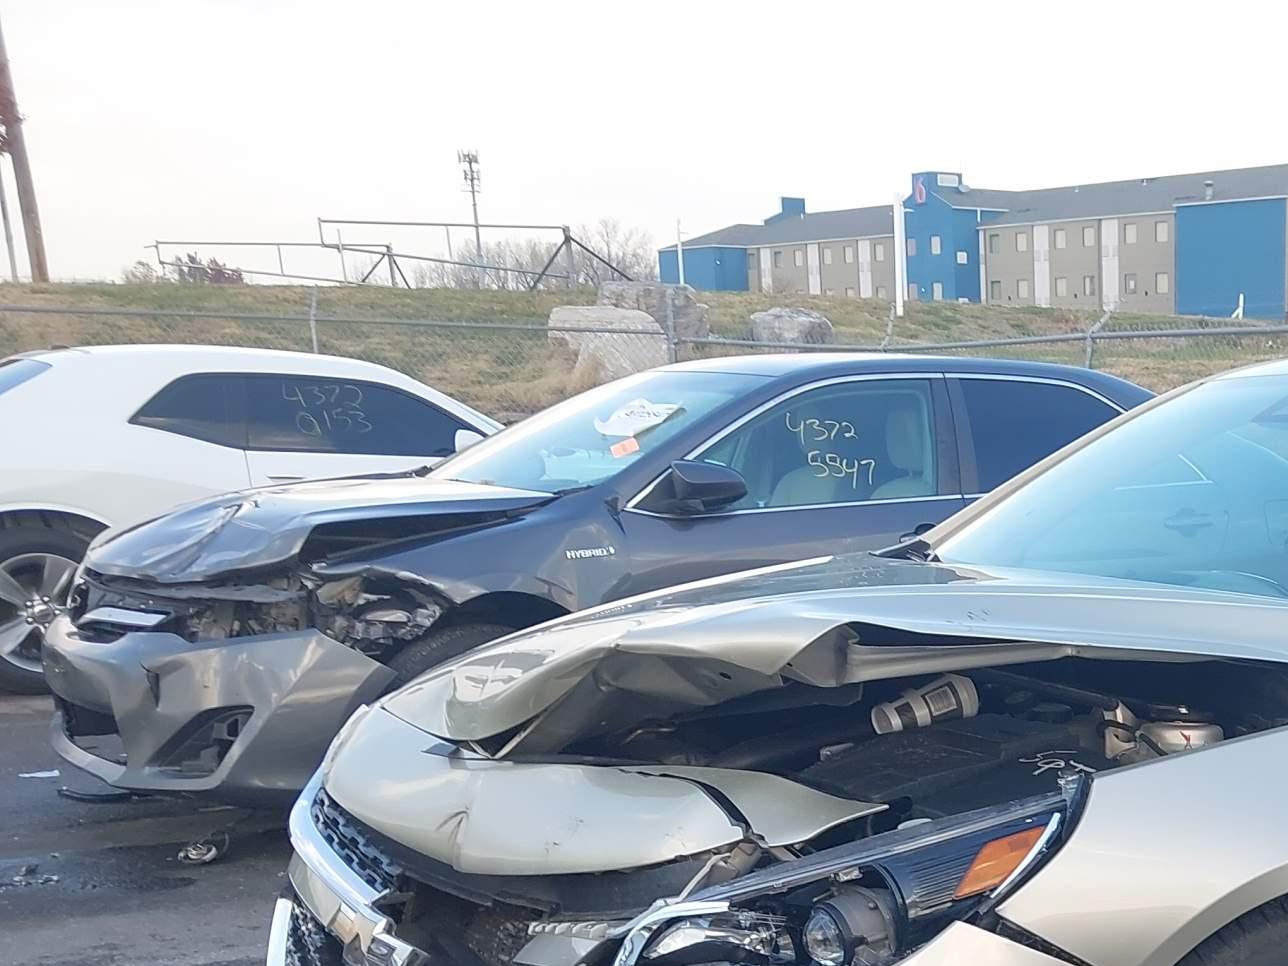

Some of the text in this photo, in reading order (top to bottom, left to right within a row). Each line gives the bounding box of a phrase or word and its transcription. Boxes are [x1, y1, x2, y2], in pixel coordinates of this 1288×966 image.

[282, 384, 362, 409] 4372
[785, 412, 858, 447] 4372
[807, 450, 876, 489] 5547
[565, 547, 609, 559] HYBRID
